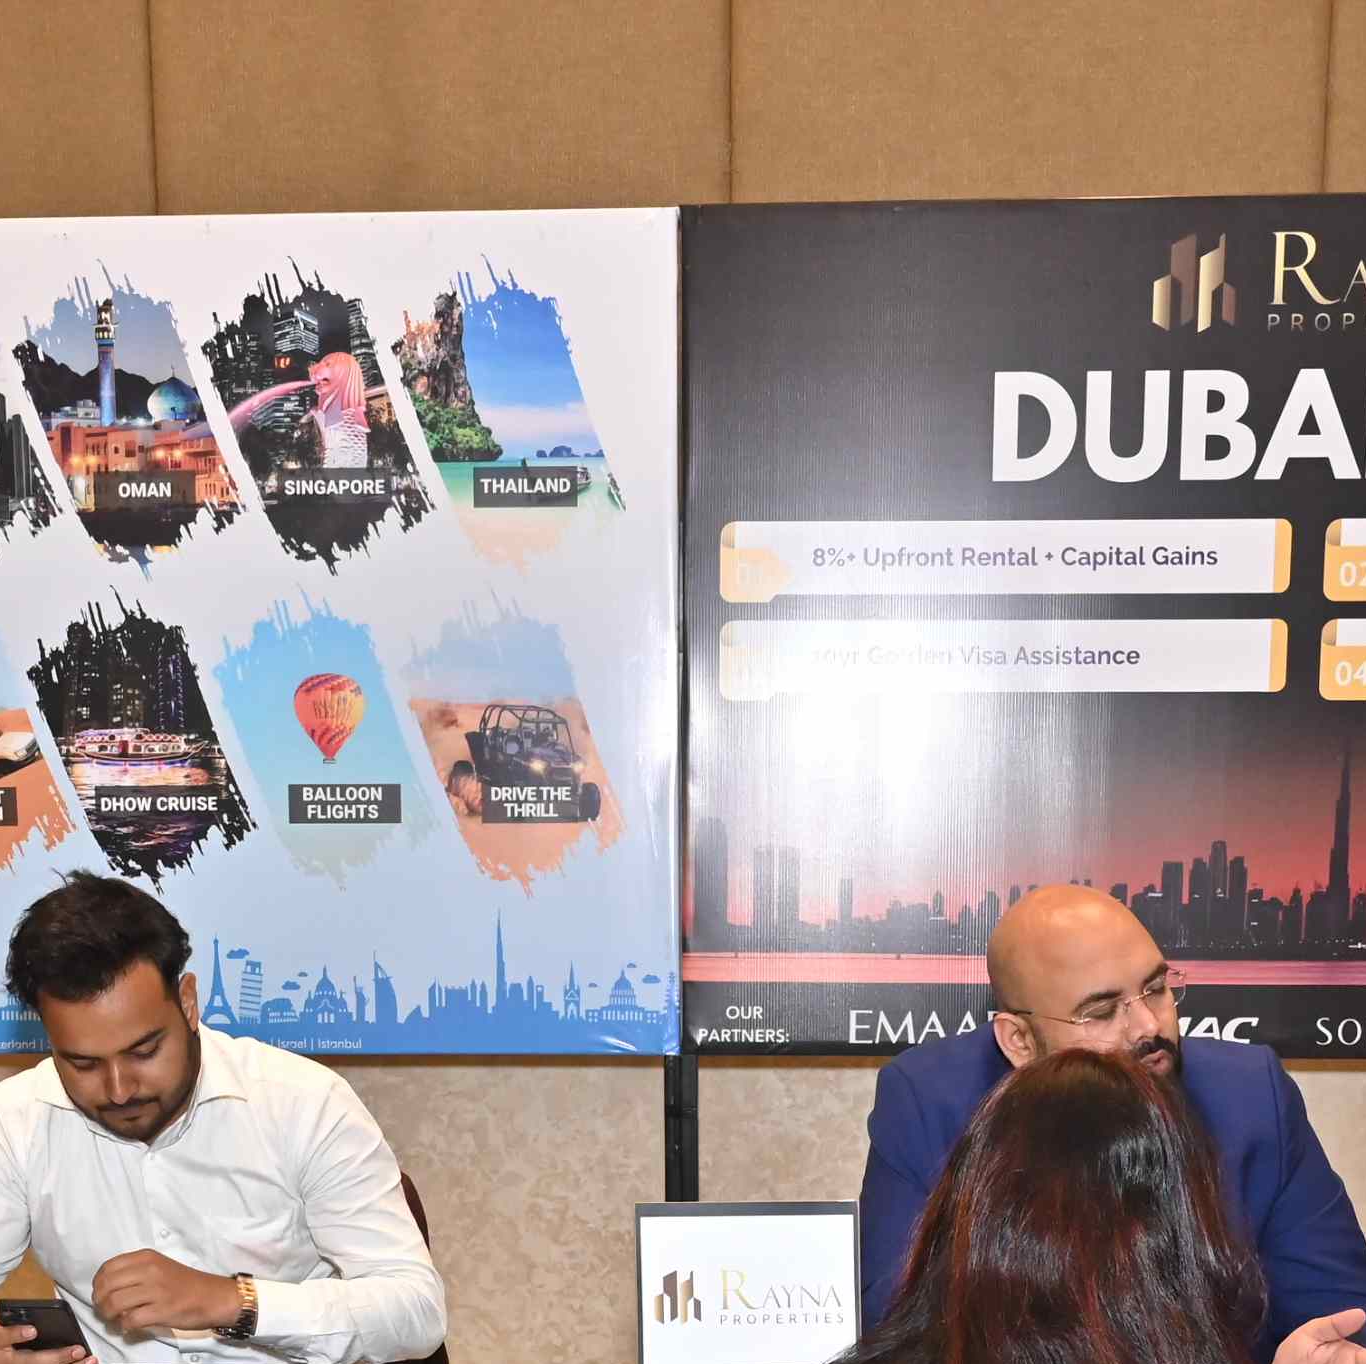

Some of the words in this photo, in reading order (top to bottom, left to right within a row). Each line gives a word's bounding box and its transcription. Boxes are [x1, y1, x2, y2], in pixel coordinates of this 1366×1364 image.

[118, 482, 171, 499] OMAN
[285, 479, 385, 496] SINGAPORE
[480, 476, 571, 495] THAILAND
[863, 546, 954, 571] Upfront
[960, 546, 1038, 567] Rental
[1060, 544, 1145, 571] Capital
[1152, 545, 1218, 566] Gains
[959, 646, 1008, 666] Visa
[1014, 646, 1141, 666] Assistance
[302, 786, 383, 802] BALLOON
[490, 786, 537, 801] DRIVE
[540, 786, 572, 801] THE
[100, 796, 152, 812] DHOW
[157, 795, 218, 812] CRUISE
[307, 803, 379, 820] FLIGHTS
[503, 802, 559, 818] THRILL
[726, 1006, 763, 1019] OUR
[698, 1028, 789, 1043] PARTNERS:
[849, 1009, 997, 1045] EMAA
[318, 1038, 362, 1049] Istanbul
[718, 1267, 843, 1311] RAYNA
[719, 1312, 844, 1326] PROPERTIES
